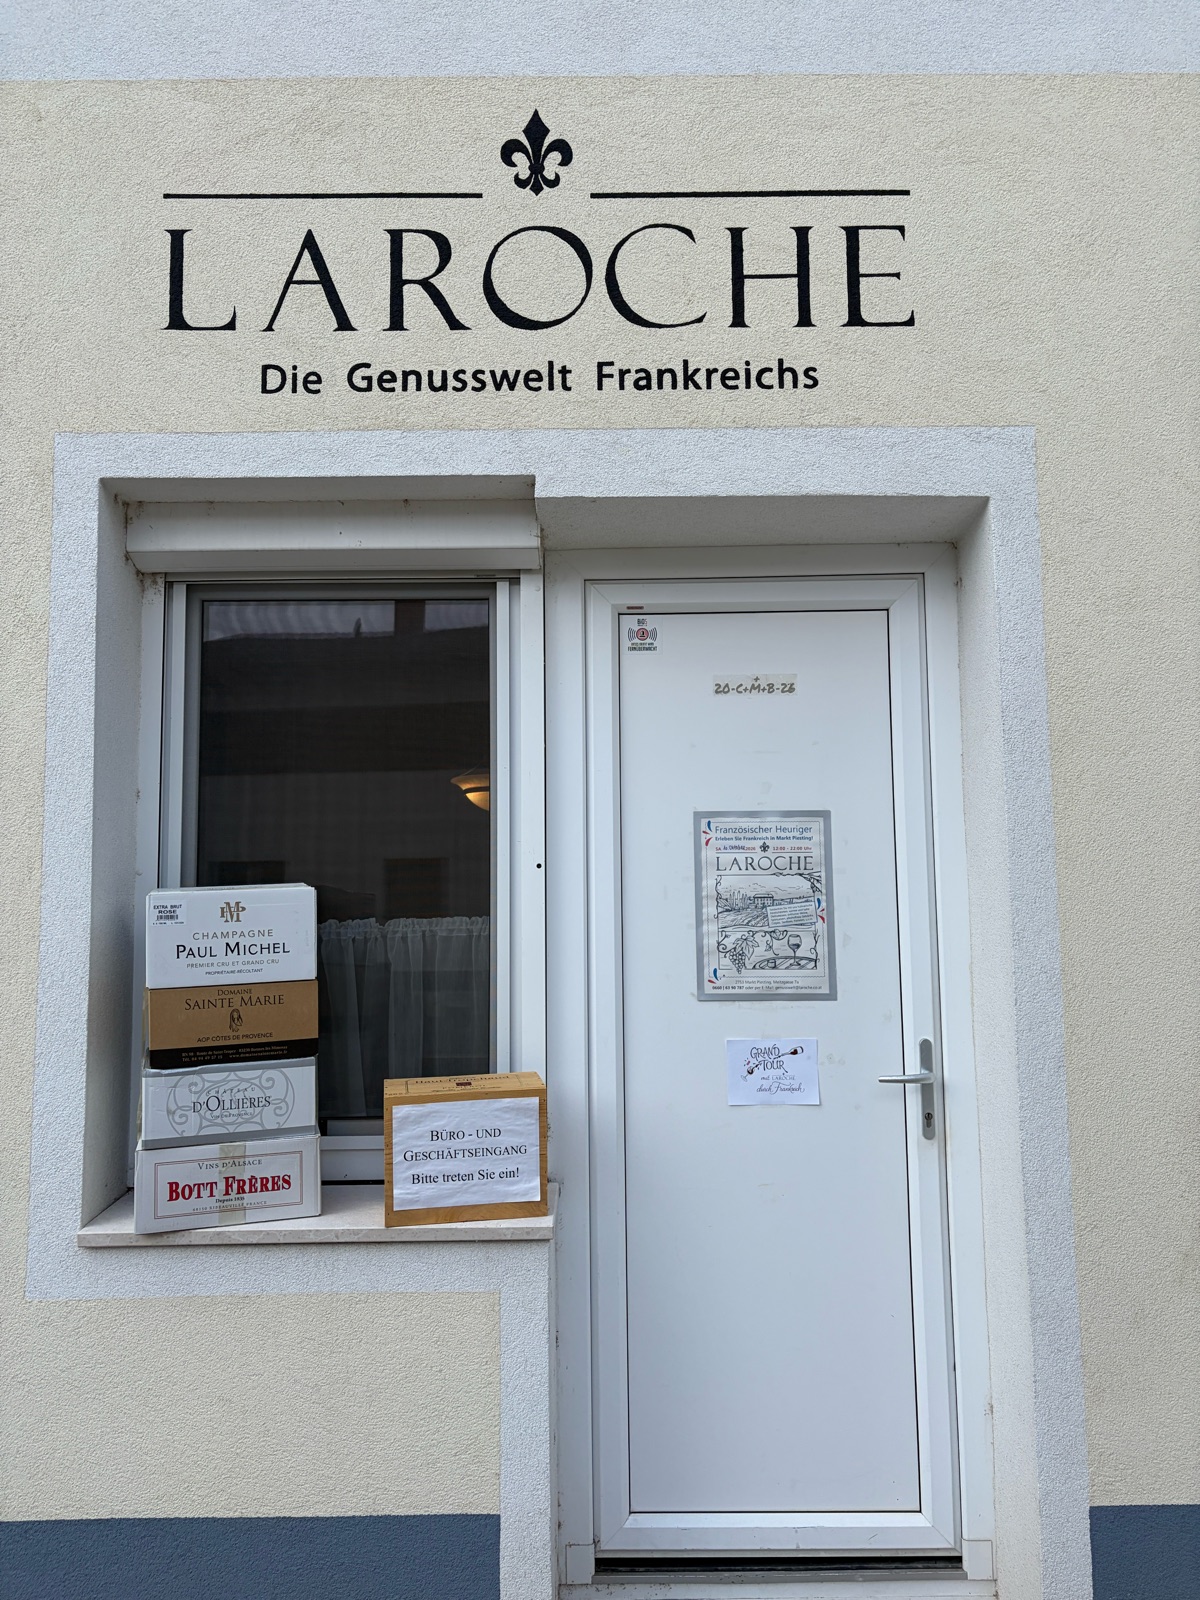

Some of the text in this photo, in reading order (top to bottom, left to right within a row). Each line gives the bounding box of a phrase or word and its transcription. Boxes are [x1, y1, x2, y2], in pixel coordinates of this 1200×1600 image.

[161, 223, 916, 332] LAROCHE
[260, 358, 819, 395] Die Genusswelt Frankreichs
[715, 825, 813, 836] Französischer Heuriger
[715, 855, 815, 872] LAROCHE
[192, 929, 274, 941] CHAMPAGNE
[175, 941, 291, 960] PAUL MICHEL
[217, 988, 253, 996] DOMAINE
[184, 994, 285, 1011] SAINTE MARIE
[241, 1032, 273, 1040] PROVENCE
[749, 1044, 781, 1061] GRAND
[760, 1059, 788, 1073] TOUR
[192, 1095, 271, 1113] D'OLLIÈRES
[430, 1129, 465, 1142] BÜRO
[476, 1128, 502, 1139] UND
[403, 1145, 528, 1162] GESCHÄFTSEINGANG
[198, 1159, 263, 1170] VINS D'ALSACE
[411, 1167, 520, 1185] Bitte treten Sie ein!
[167, 1174, 291, 1202] BOTT FRÈRES
